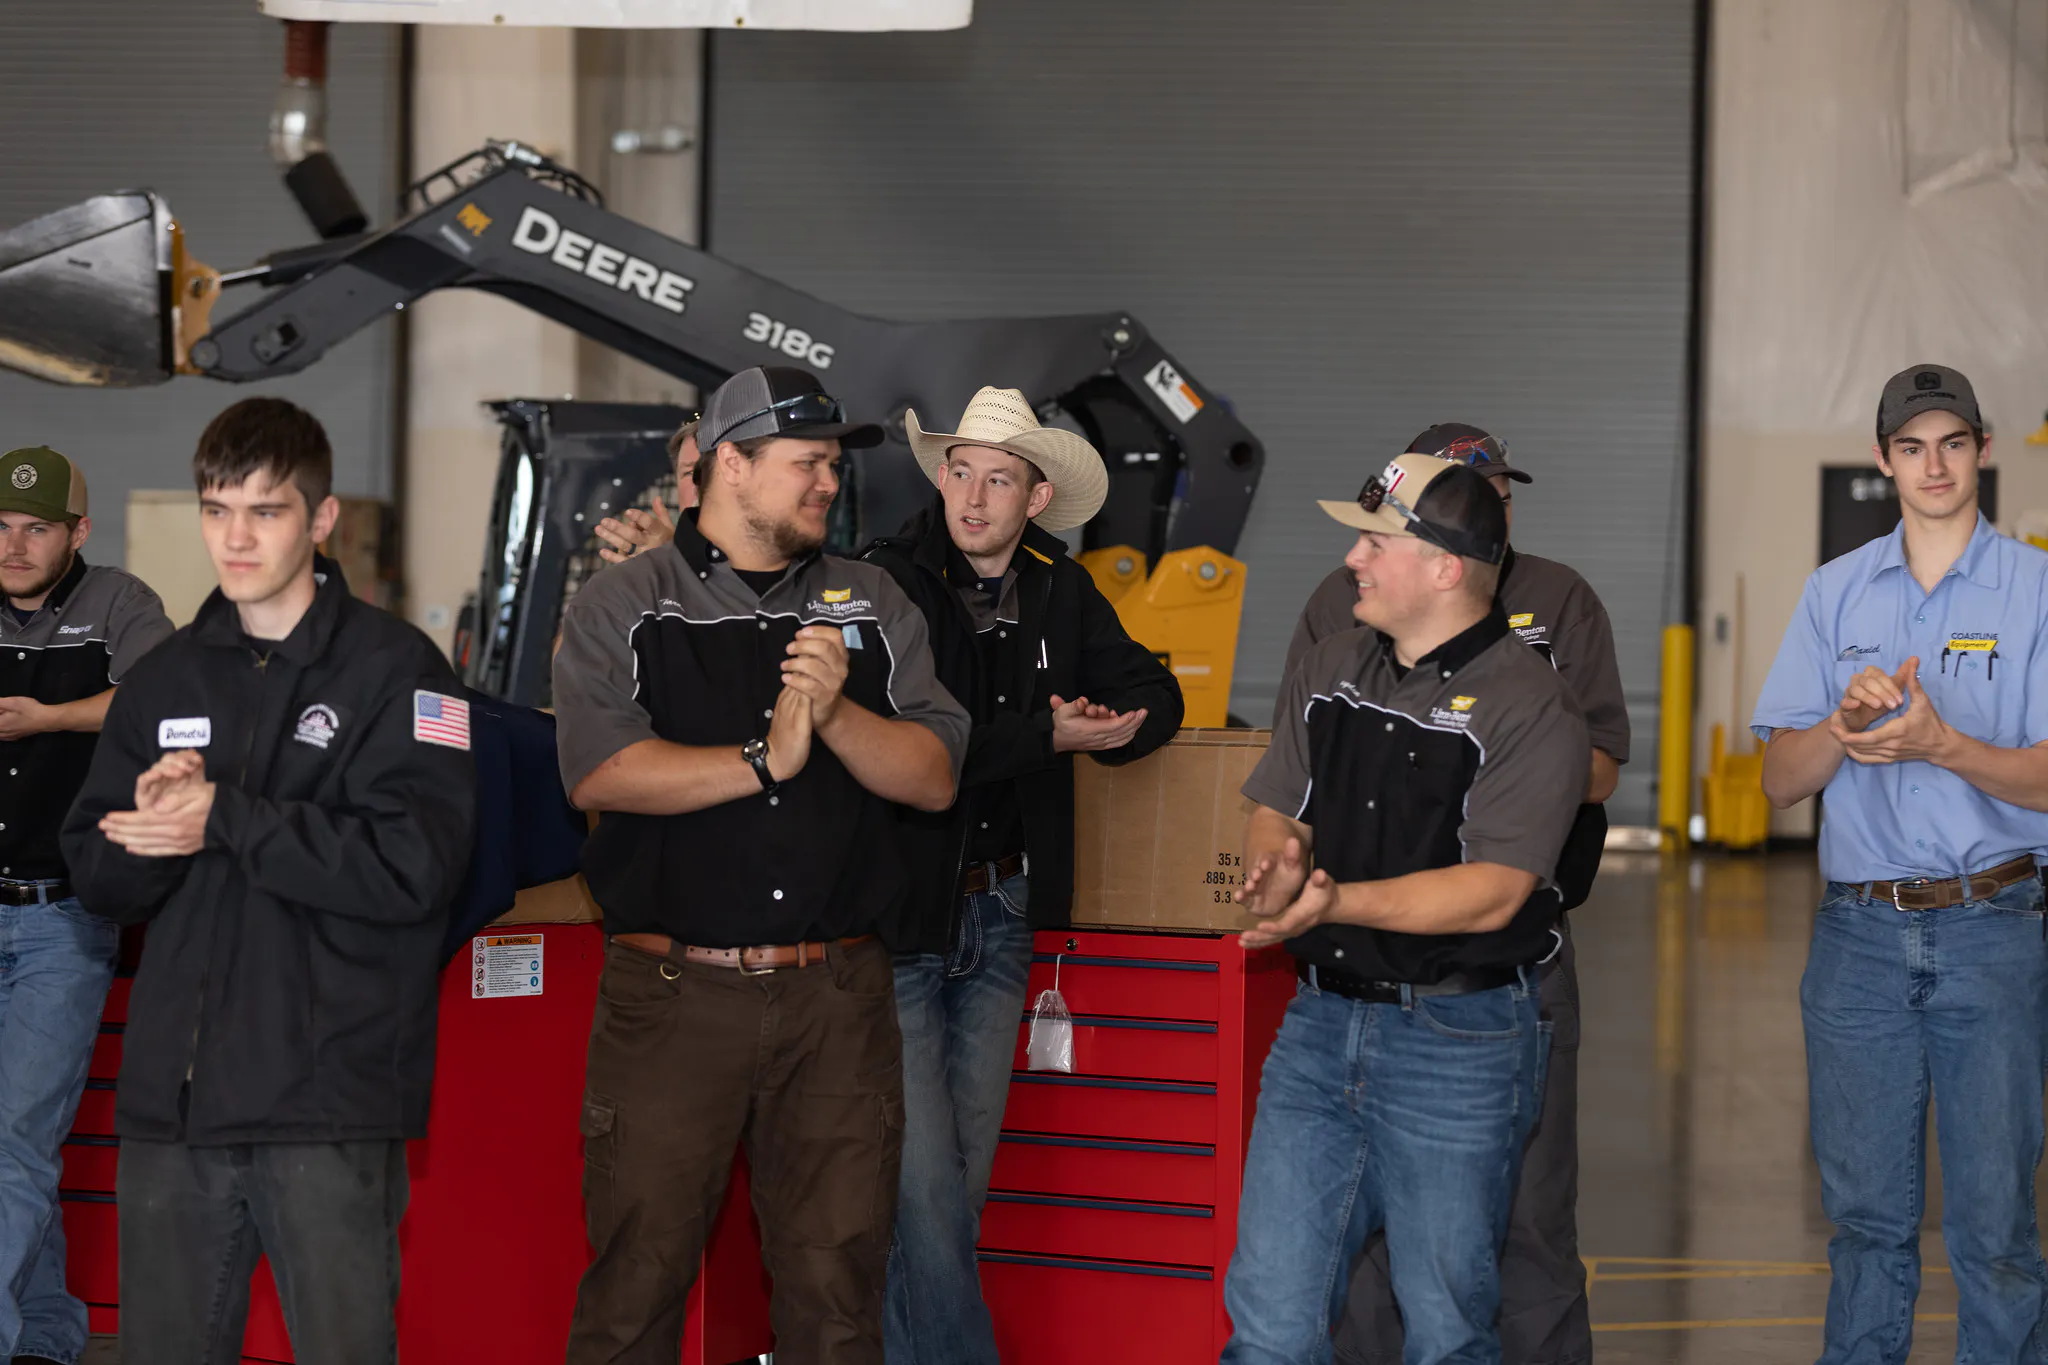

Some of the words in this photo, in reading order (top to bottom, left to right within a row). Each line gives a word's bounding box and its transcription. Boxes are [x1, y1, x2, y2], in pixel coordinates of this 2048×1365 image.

[511, 205, 694, 313] DEERE
[742, 312, 835, 369] 318G
[1514, 626, 1546, 636] Benton
[1951, 632, 1998, 641] COASTLINE
[1951, 641, 1987, 649] Equipment
[1218, 853, 1231, 866] 35
[1234, 856, 1240, 866] x
[1203, 871, 1226, 884] .889
[1228, 874, 1234, 885] x
[1214, 890, 1231, 904] 3.3
[503, 937, 532, 945] WARNING
